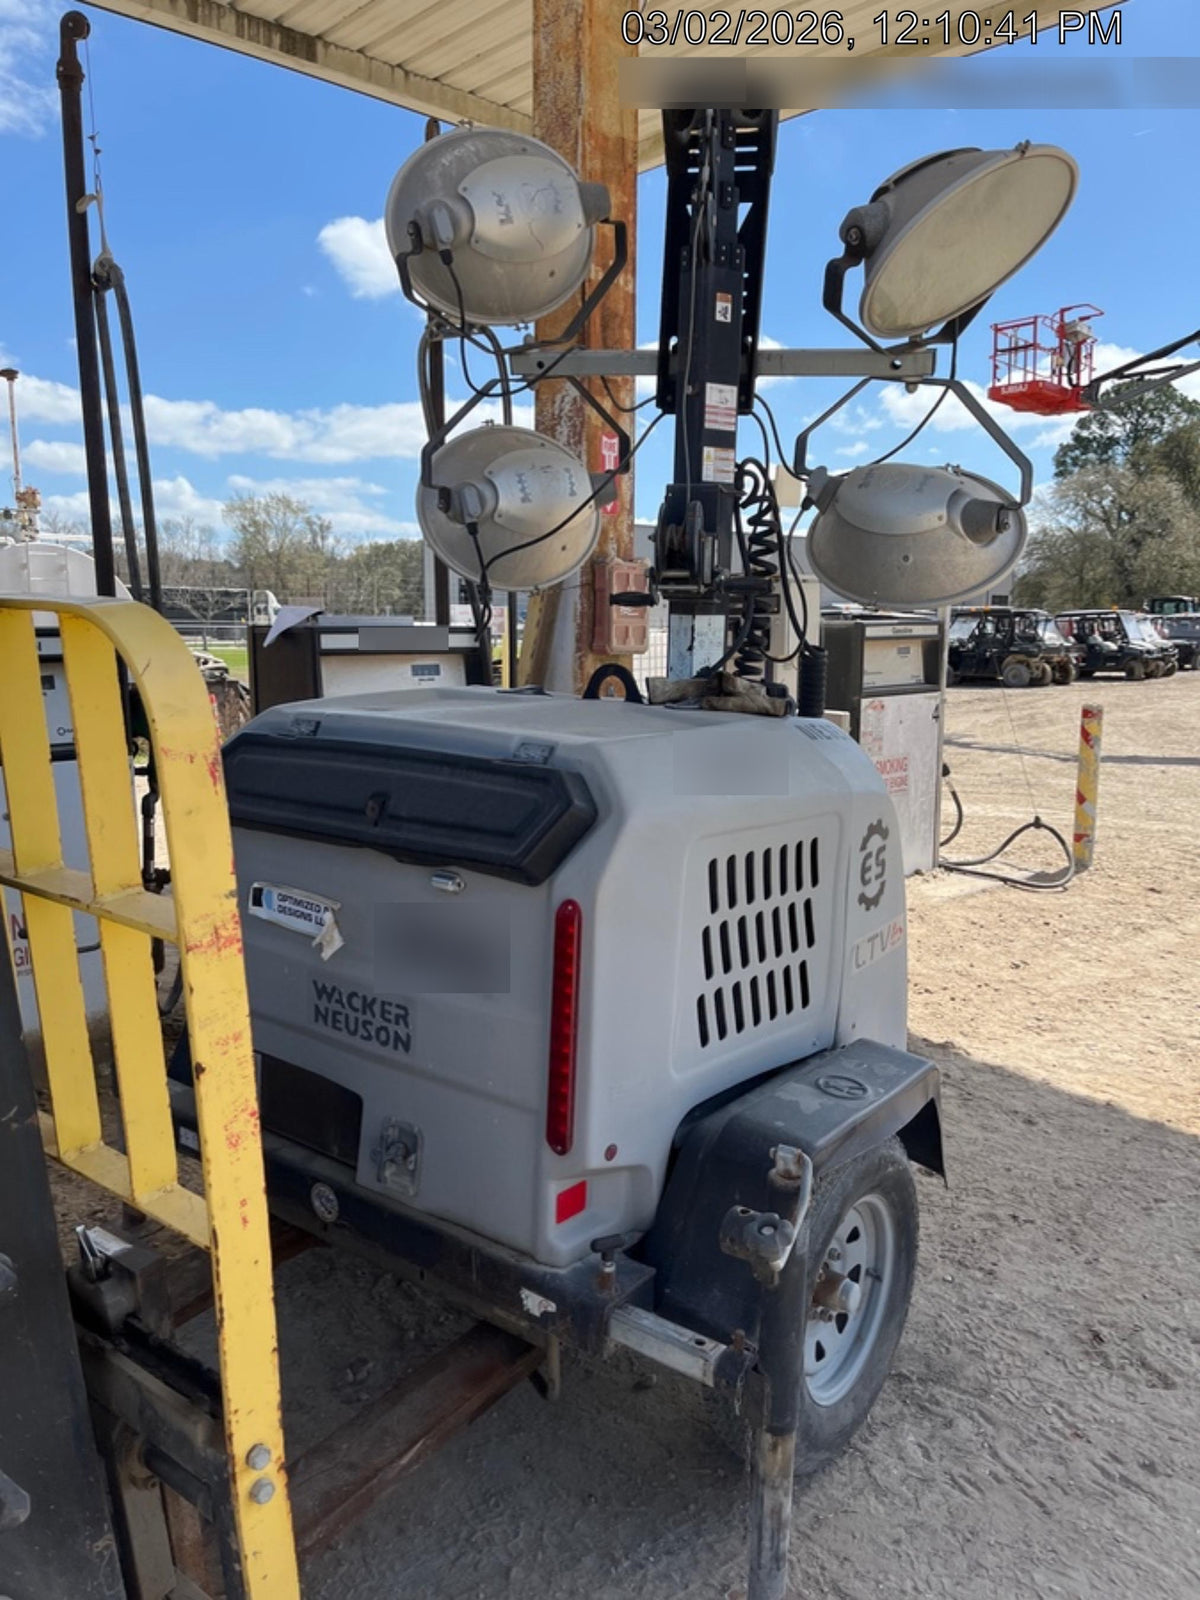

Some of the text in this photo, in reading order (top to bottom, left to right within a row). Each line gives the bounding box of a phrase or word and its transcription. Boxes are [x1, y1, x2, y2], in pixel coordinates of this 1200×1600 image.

[277, 892, 322, 914] OPTIMIZED
[277, 904, 313, 923] DESIGNS
[311, 979, 410, 1030] WACKER
[314, 1004, 411, 1054] NEUSON
